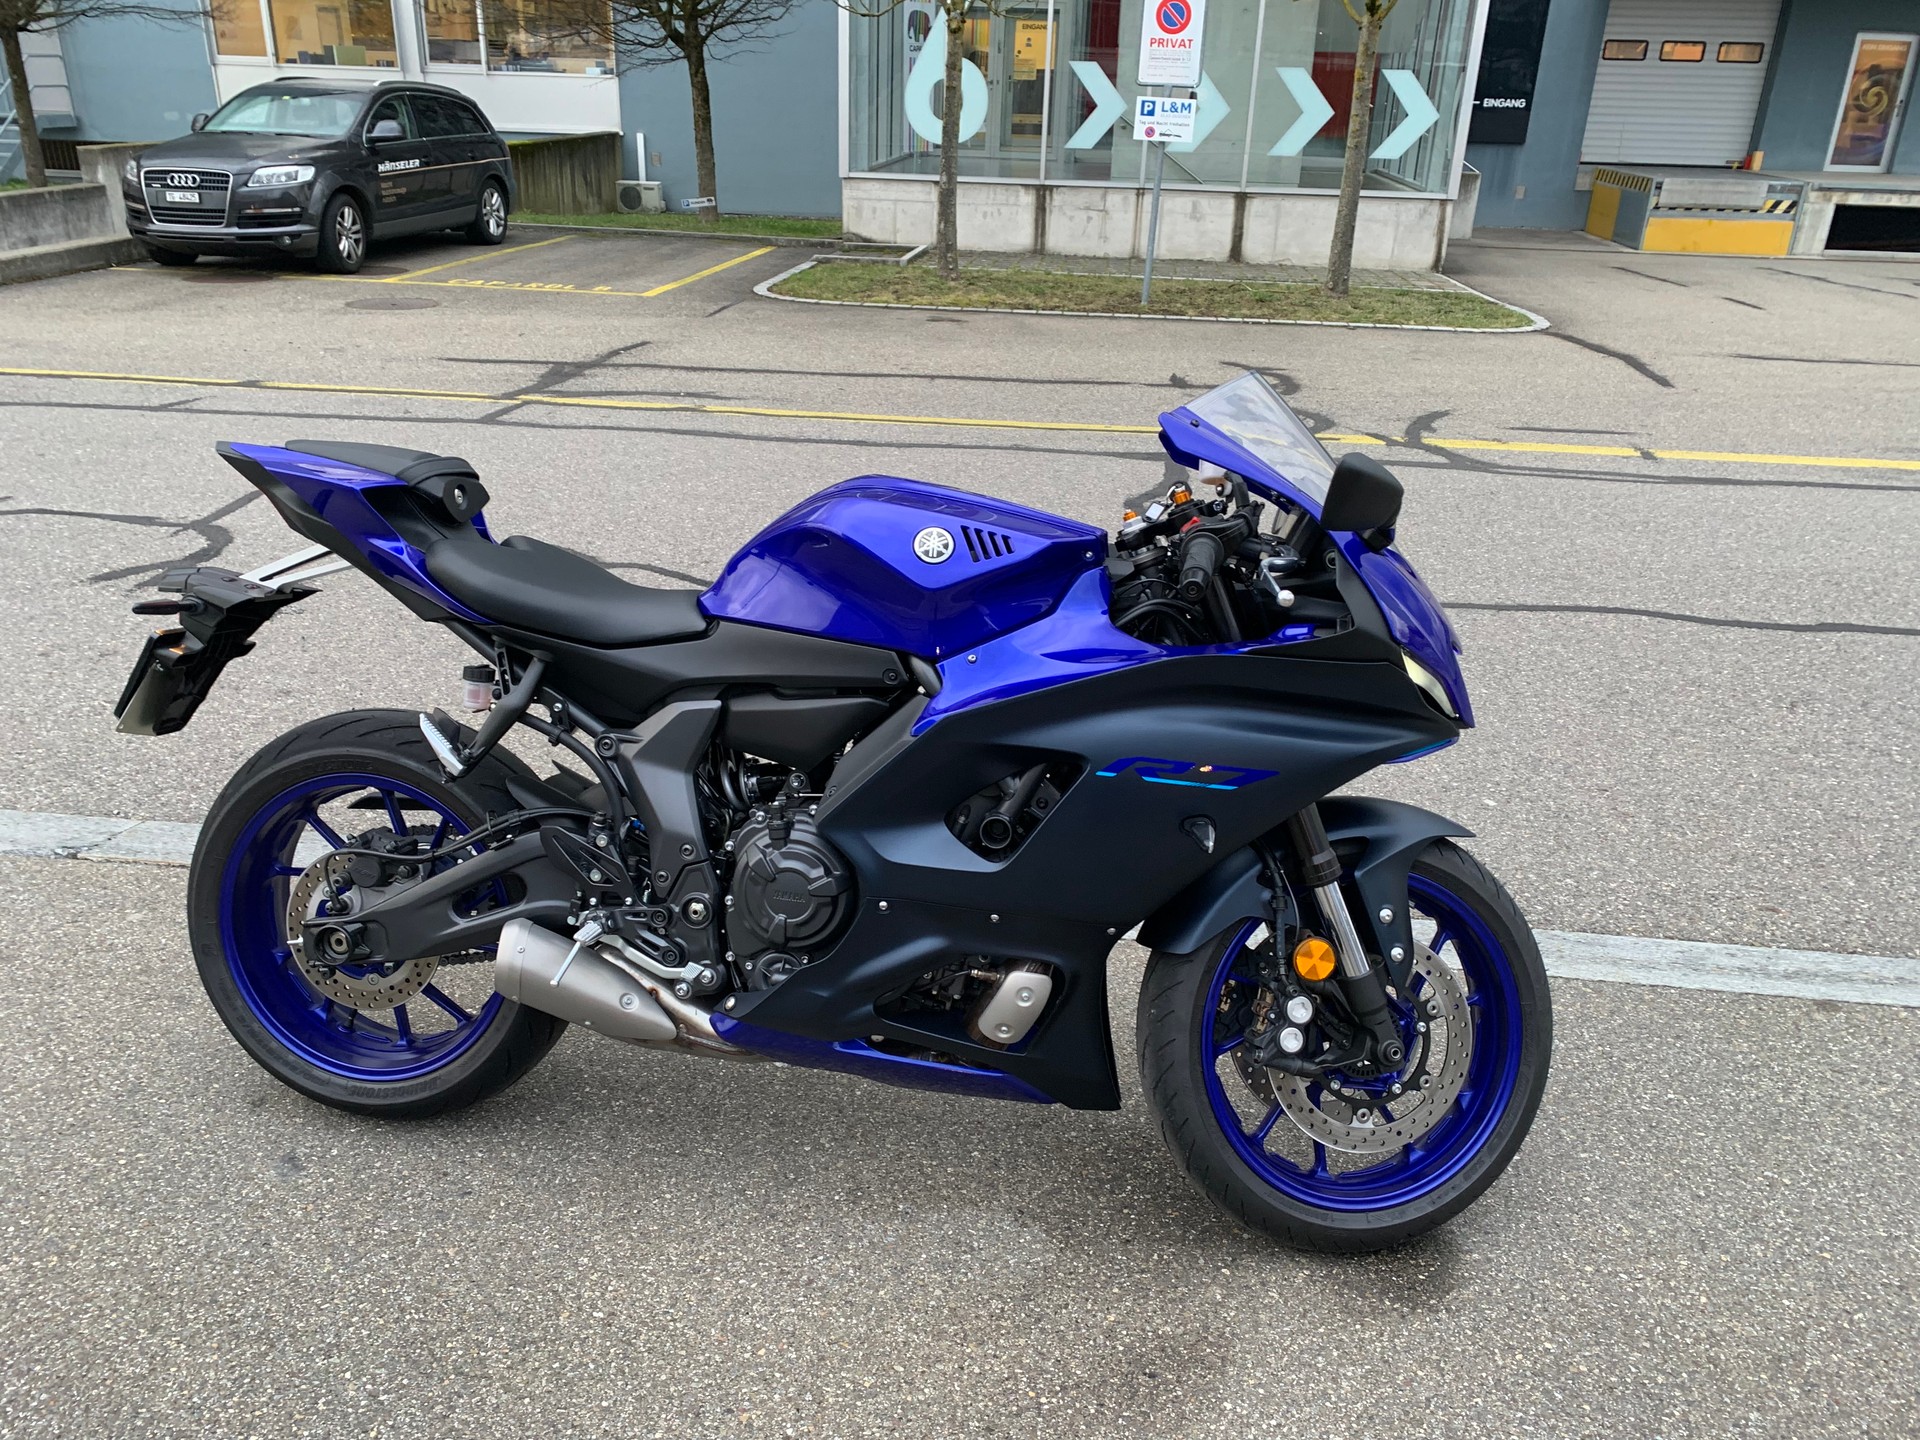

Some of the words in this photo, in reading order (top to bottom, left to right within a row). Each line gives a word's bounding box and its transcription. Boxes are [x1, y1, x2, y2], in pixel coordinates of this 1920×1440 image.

[1149, 37, 1193, 49] PRIVAT
[1161, 101, 1191, 113] L&M
[1483, 98, 1527, 108] EINGANG
